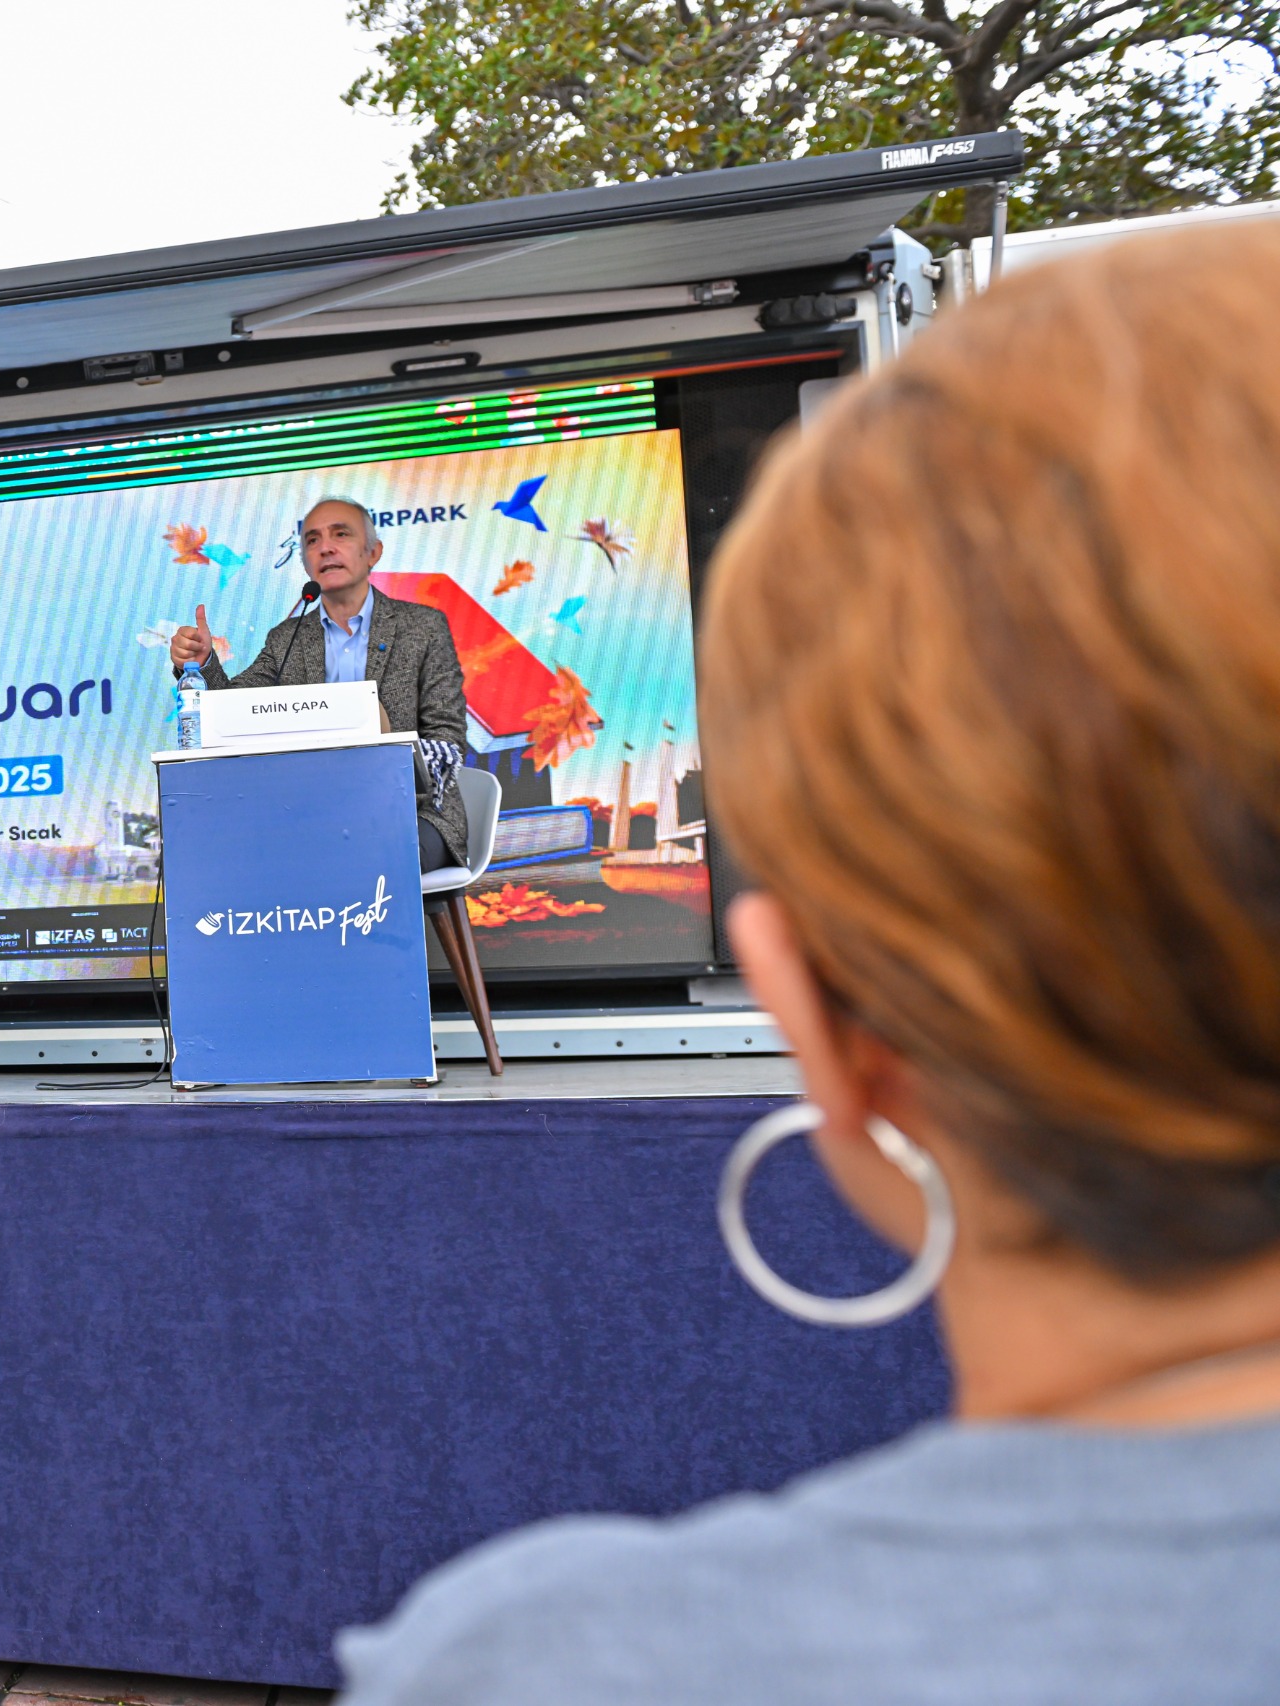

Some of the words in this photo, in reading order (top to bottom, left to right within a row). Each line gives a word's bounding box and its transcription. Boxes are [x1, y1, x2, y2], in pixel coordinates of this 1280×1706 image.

[881, 146, 931, 170] FIAMMA
[251, 702, 288, 714] EMİN
[292, 700, 329, 714] ÇAPA
[8, 824, 62, 841] Sıcak
[227, 905, 334, 936] İZKİTAP
[340, 875, 392, 946] Fest
[120, 926, 149, 938] TACT
